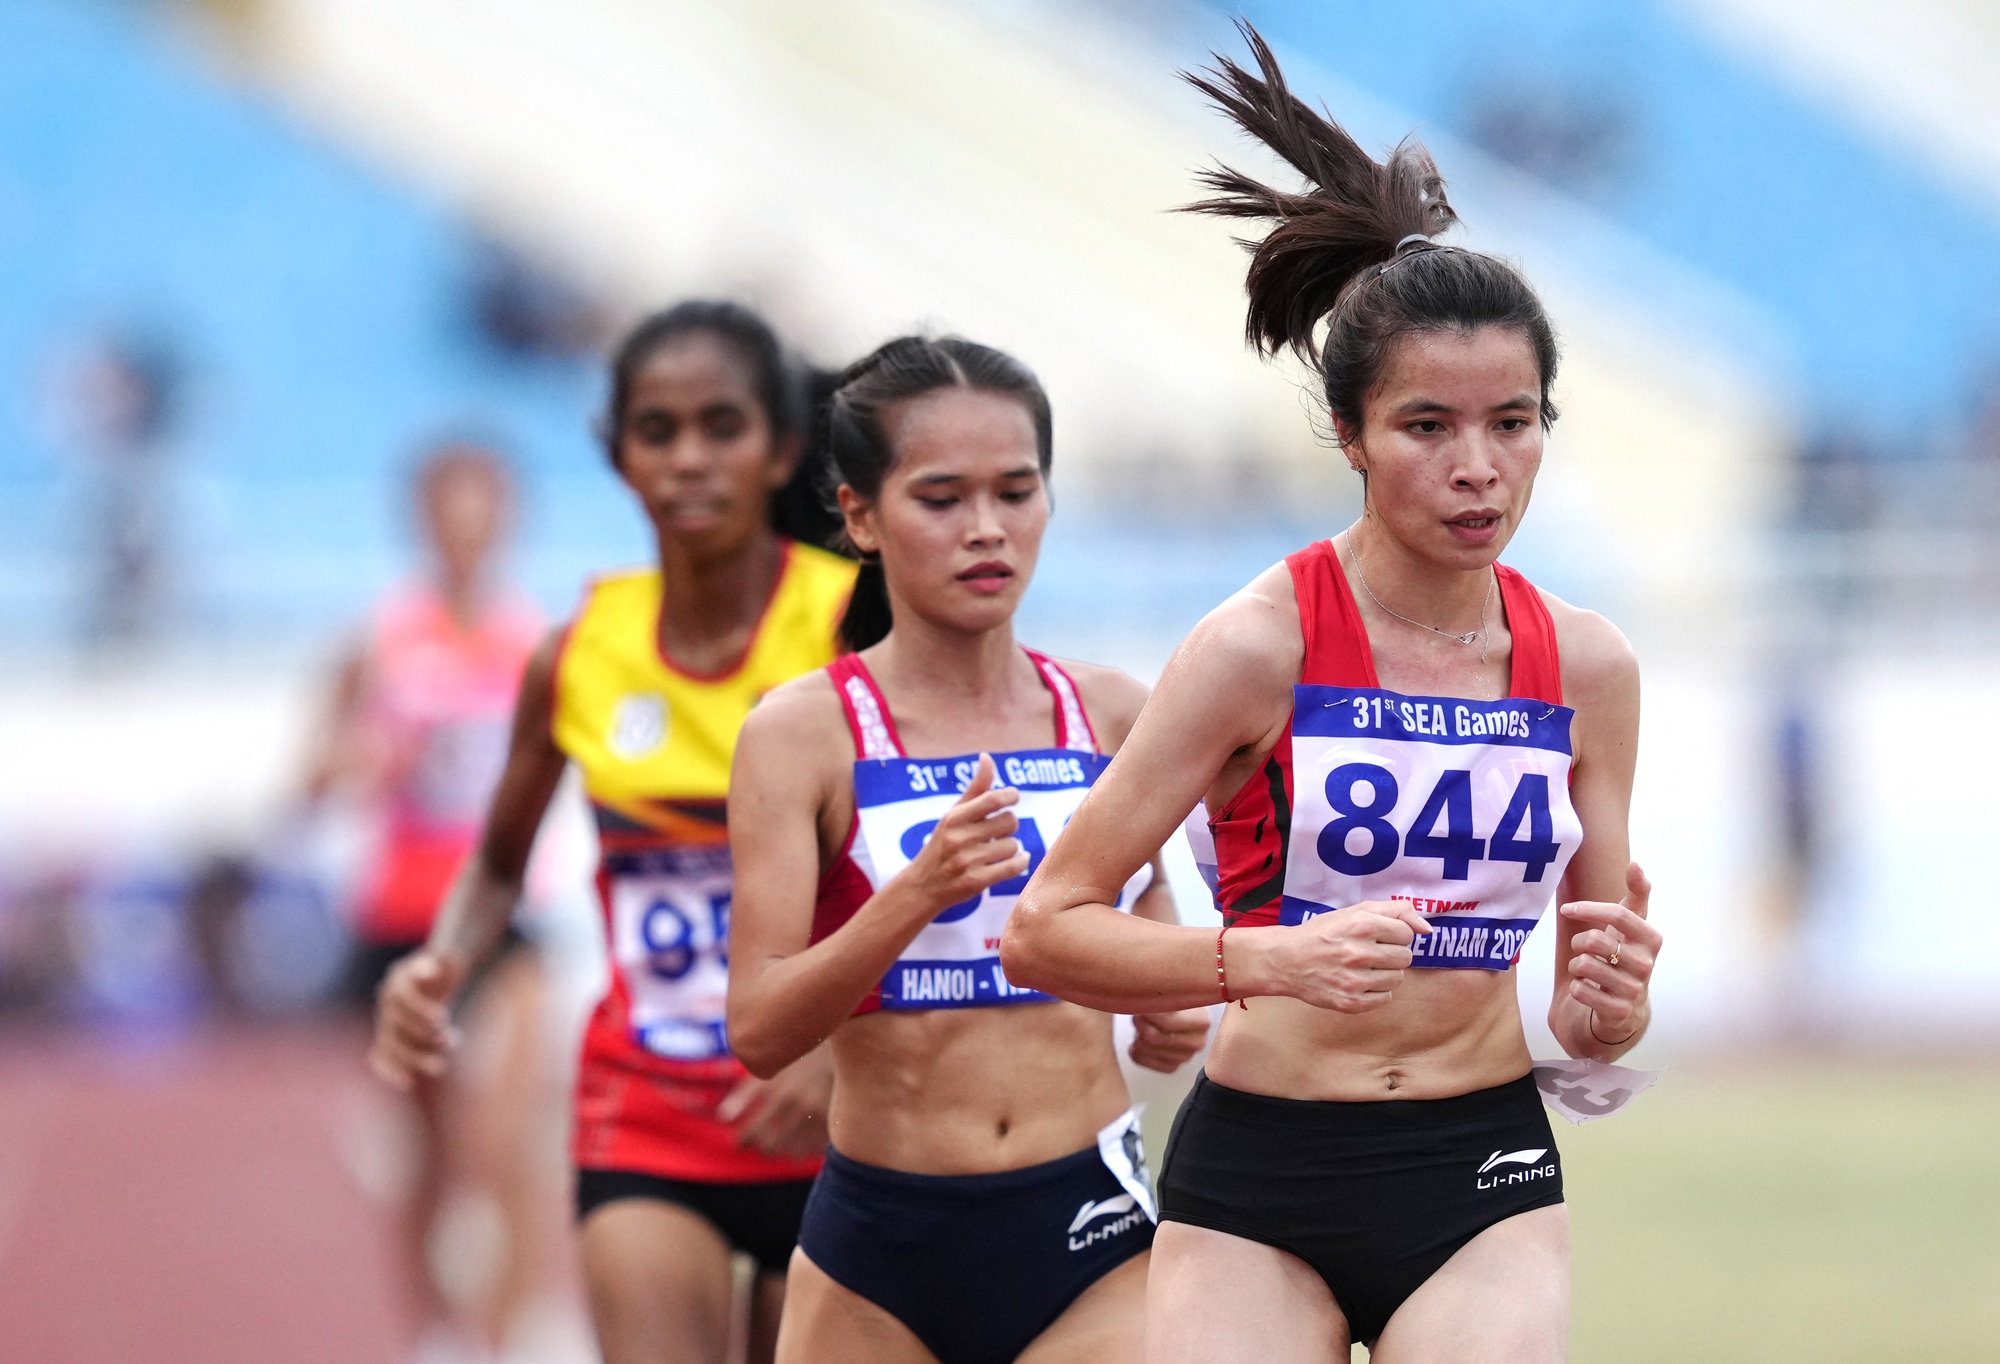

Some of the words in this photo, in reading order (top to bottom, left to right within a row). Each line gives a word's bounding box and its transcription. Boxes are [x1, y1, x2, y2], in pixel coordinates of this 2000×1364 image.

[1400, 701, 1448, 736] SEA
[1454, 705, 1530, 738] Games
[1005, 757, 1085, 785] Games
[1316, 762, 1562, 883] 844
[1406, 926, 1489, 957] ETNAM
[1490, 928, 1533, 960] 202
[902, 968, 975, 1000] HANOI
[1477, 1164, 1555, 1190] LI-NING
